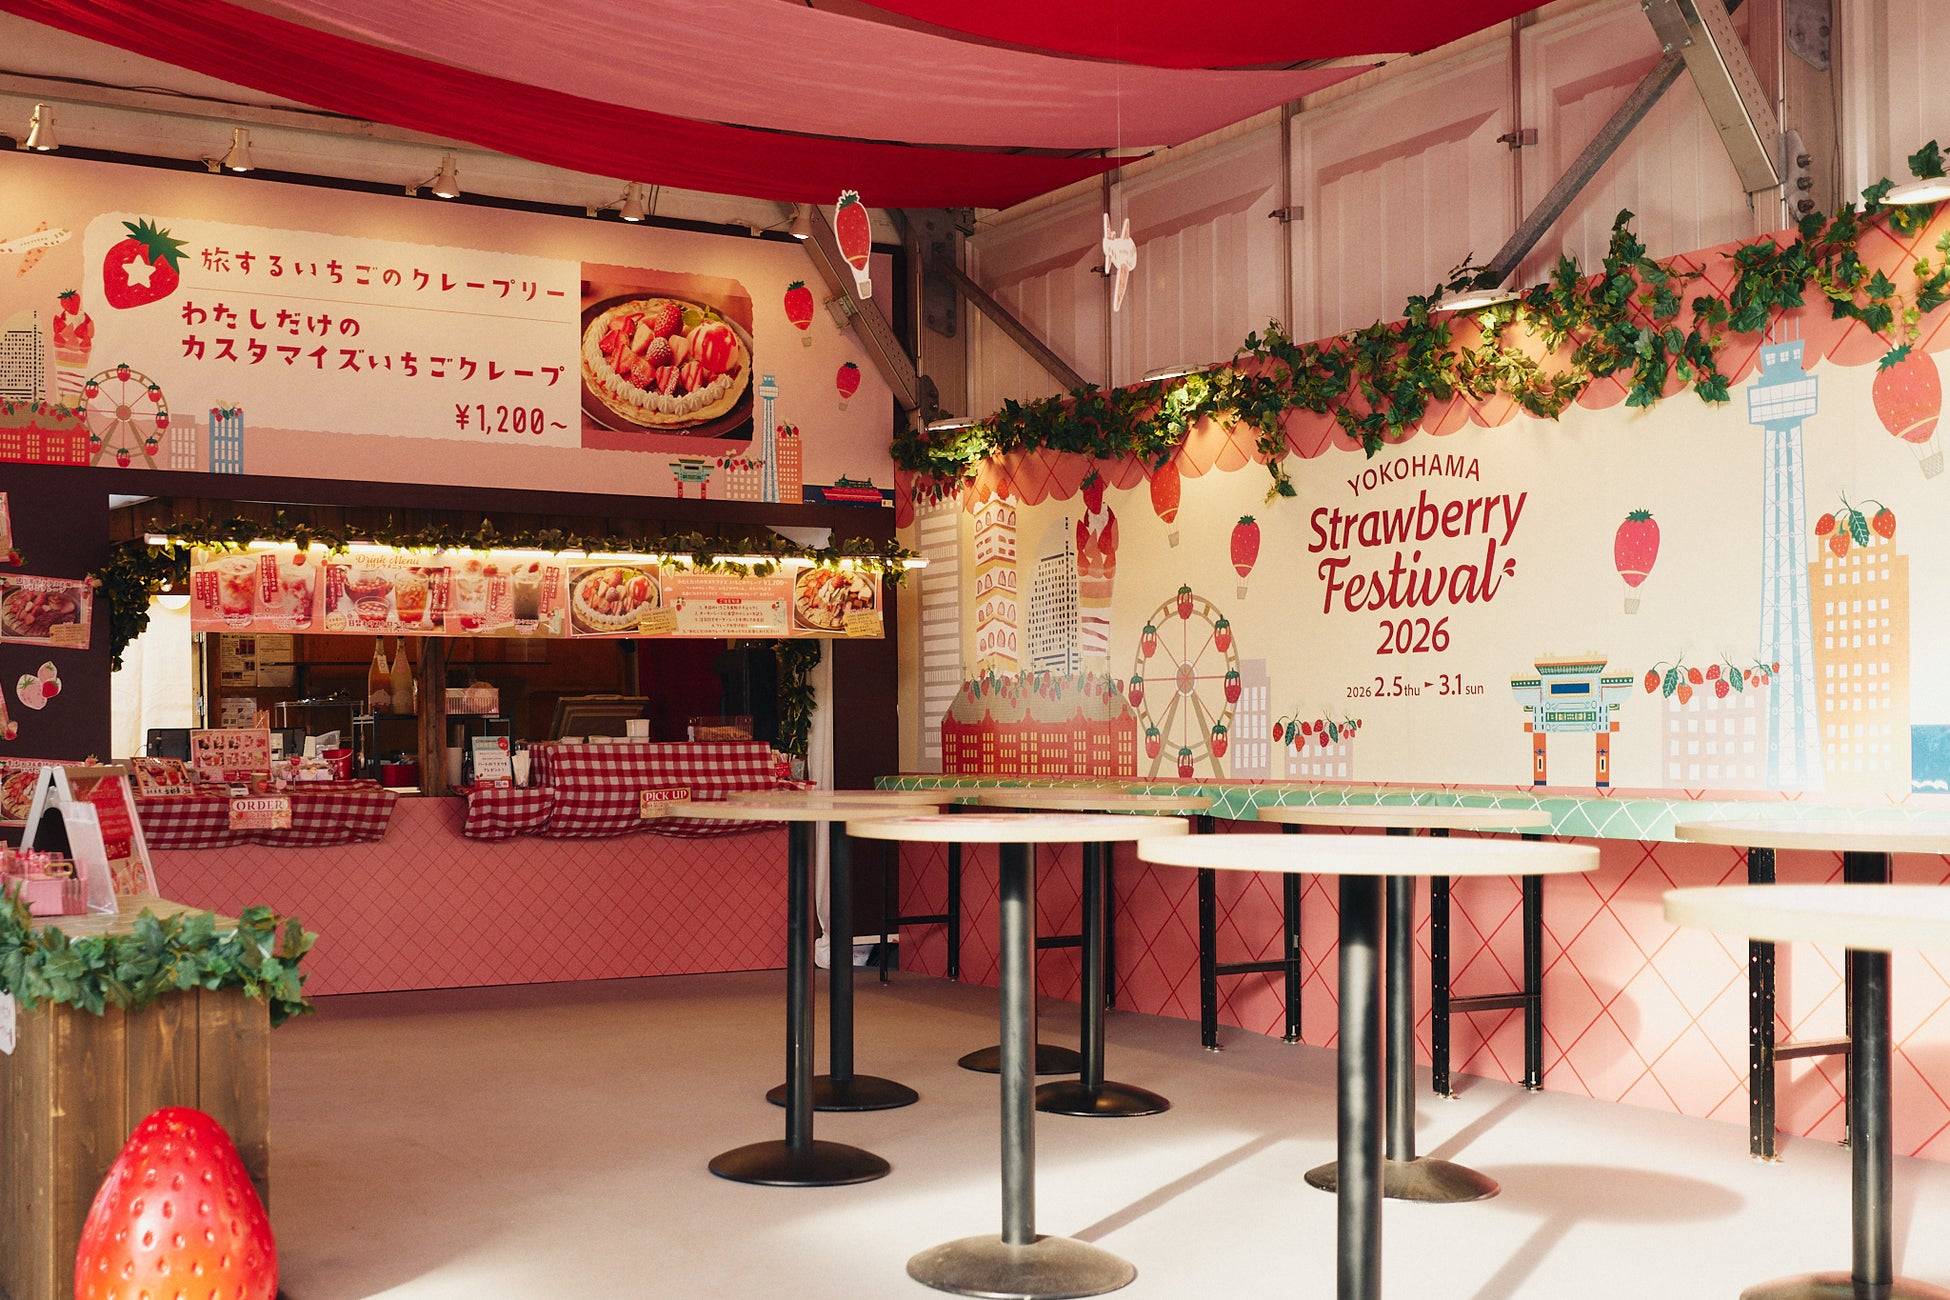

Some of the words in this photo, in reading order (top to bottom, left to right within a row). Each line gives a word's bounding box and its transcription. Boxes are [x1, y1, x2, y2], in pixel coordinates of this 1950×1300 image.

[202, 247, 567, 300] 旅するいちごのクレープリー
[181, 301, 362, 338] わたしだけの
[180, 335, 566, 388] カスタマイズいちごクレープ
[1347, 453, 1481, 498] YOKOHAMA
[1308, 488, 1529, 556] Strawberry
[1318, 537, 1506, 616] Festival
[1376, 616, 1452, 657] 2026
[1346, 685, 1372, 698] 2026
[236, 793, 284, 810] ORDER
[645, 791, 670, 802] PICK
[672, 789, 687, 799] UP
